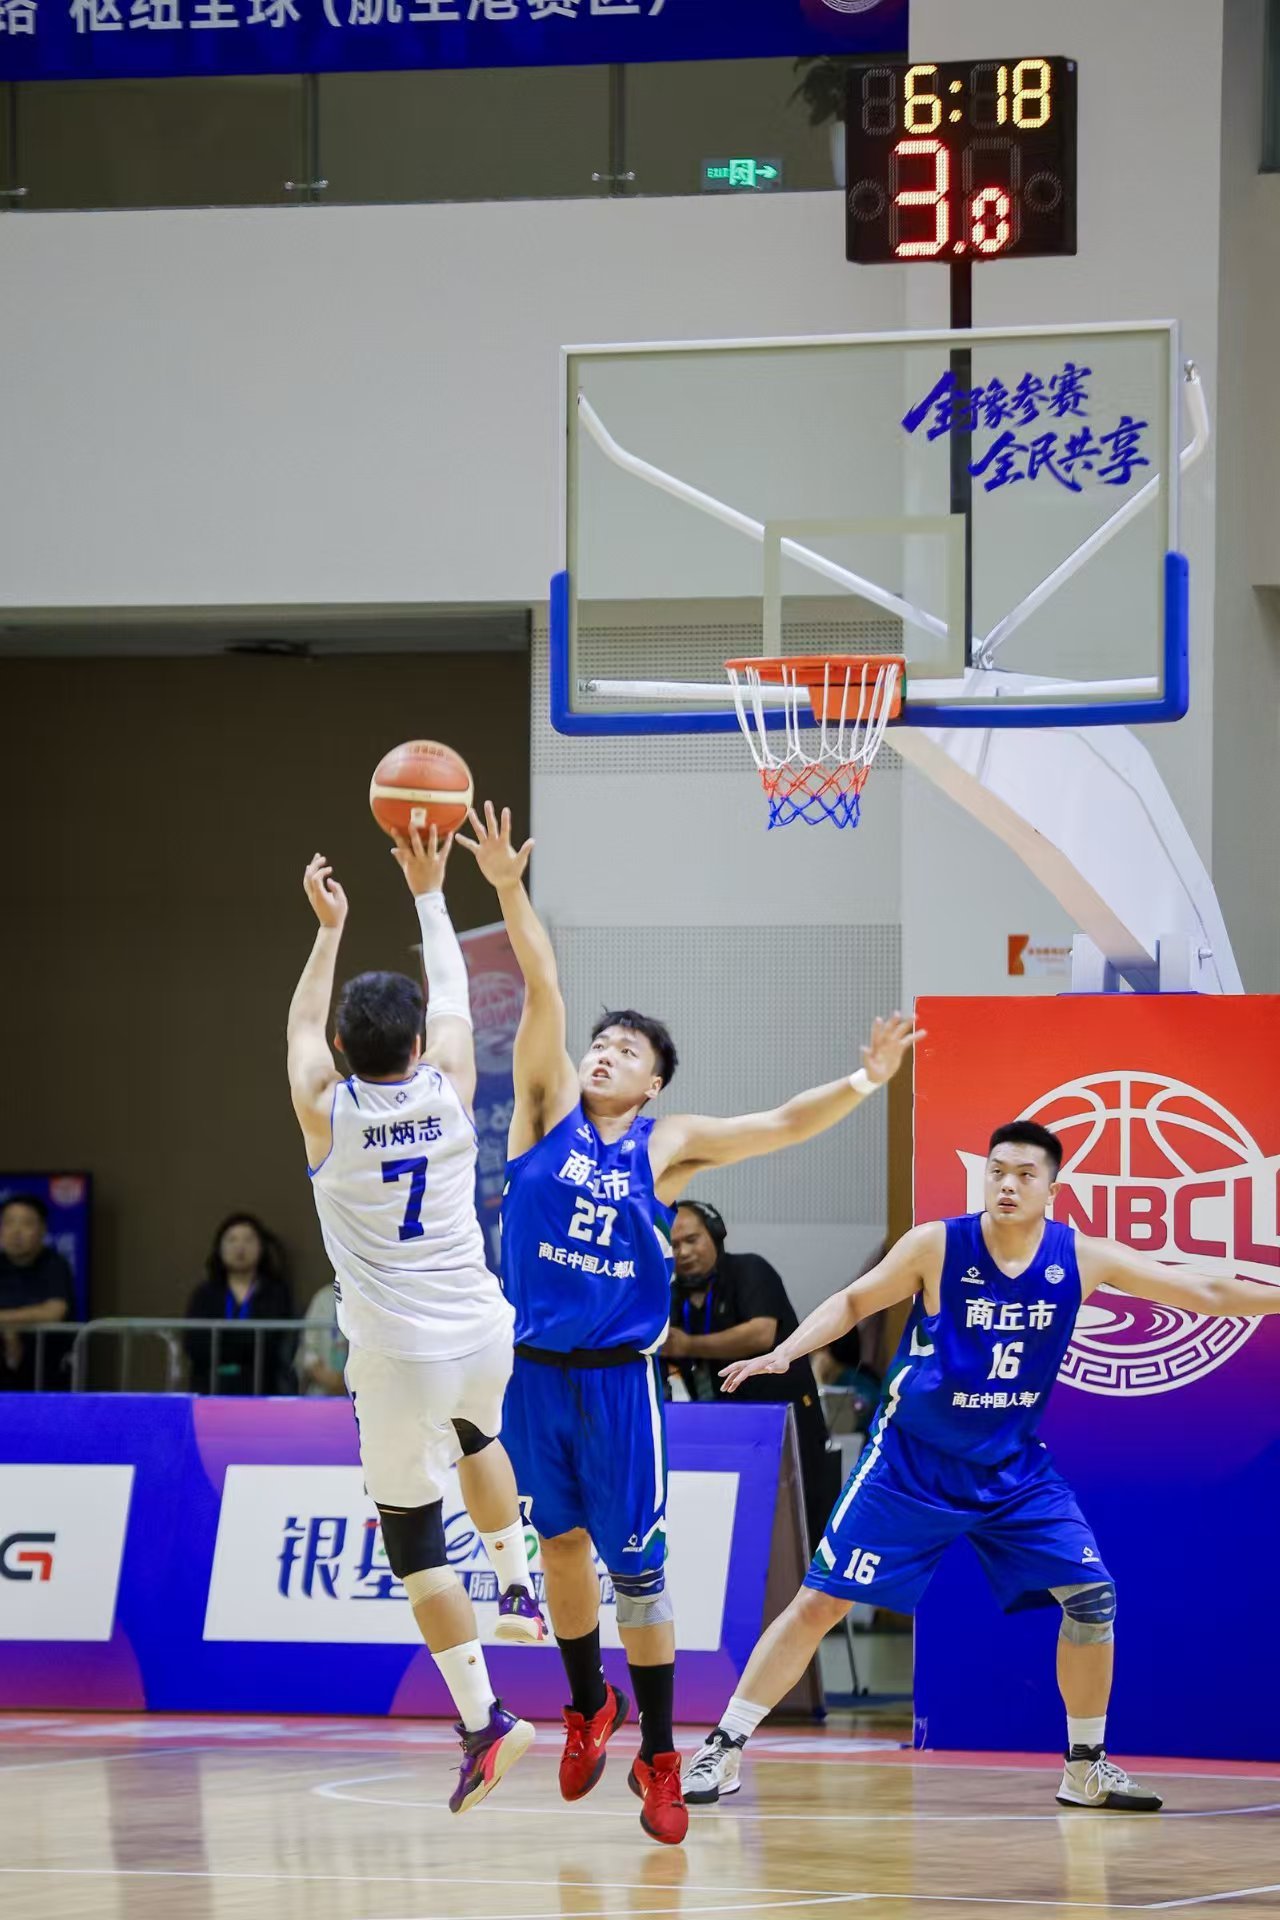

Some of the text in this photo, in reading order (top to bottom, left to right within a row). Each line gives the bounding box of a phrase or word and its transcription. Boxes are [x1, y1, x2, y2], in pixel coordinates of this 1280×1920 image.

[904, 59, 1051, 134] 6:18
[707, 167, 728, 178] EXIT
[895, 140, 1009, 256] 3.0
[967, 415, 1149, 493] 全民共享
[362, 1115, 443, 1149] 刘炳志
[381, 1156, 428, 1240] 7
[568, 1196, 618, 1246] 27
[965, 1298, 1057, 1331] 商丘市
[987, 1341, 1024, 1380] 16
[843, 1548, 881, 1585] 16
